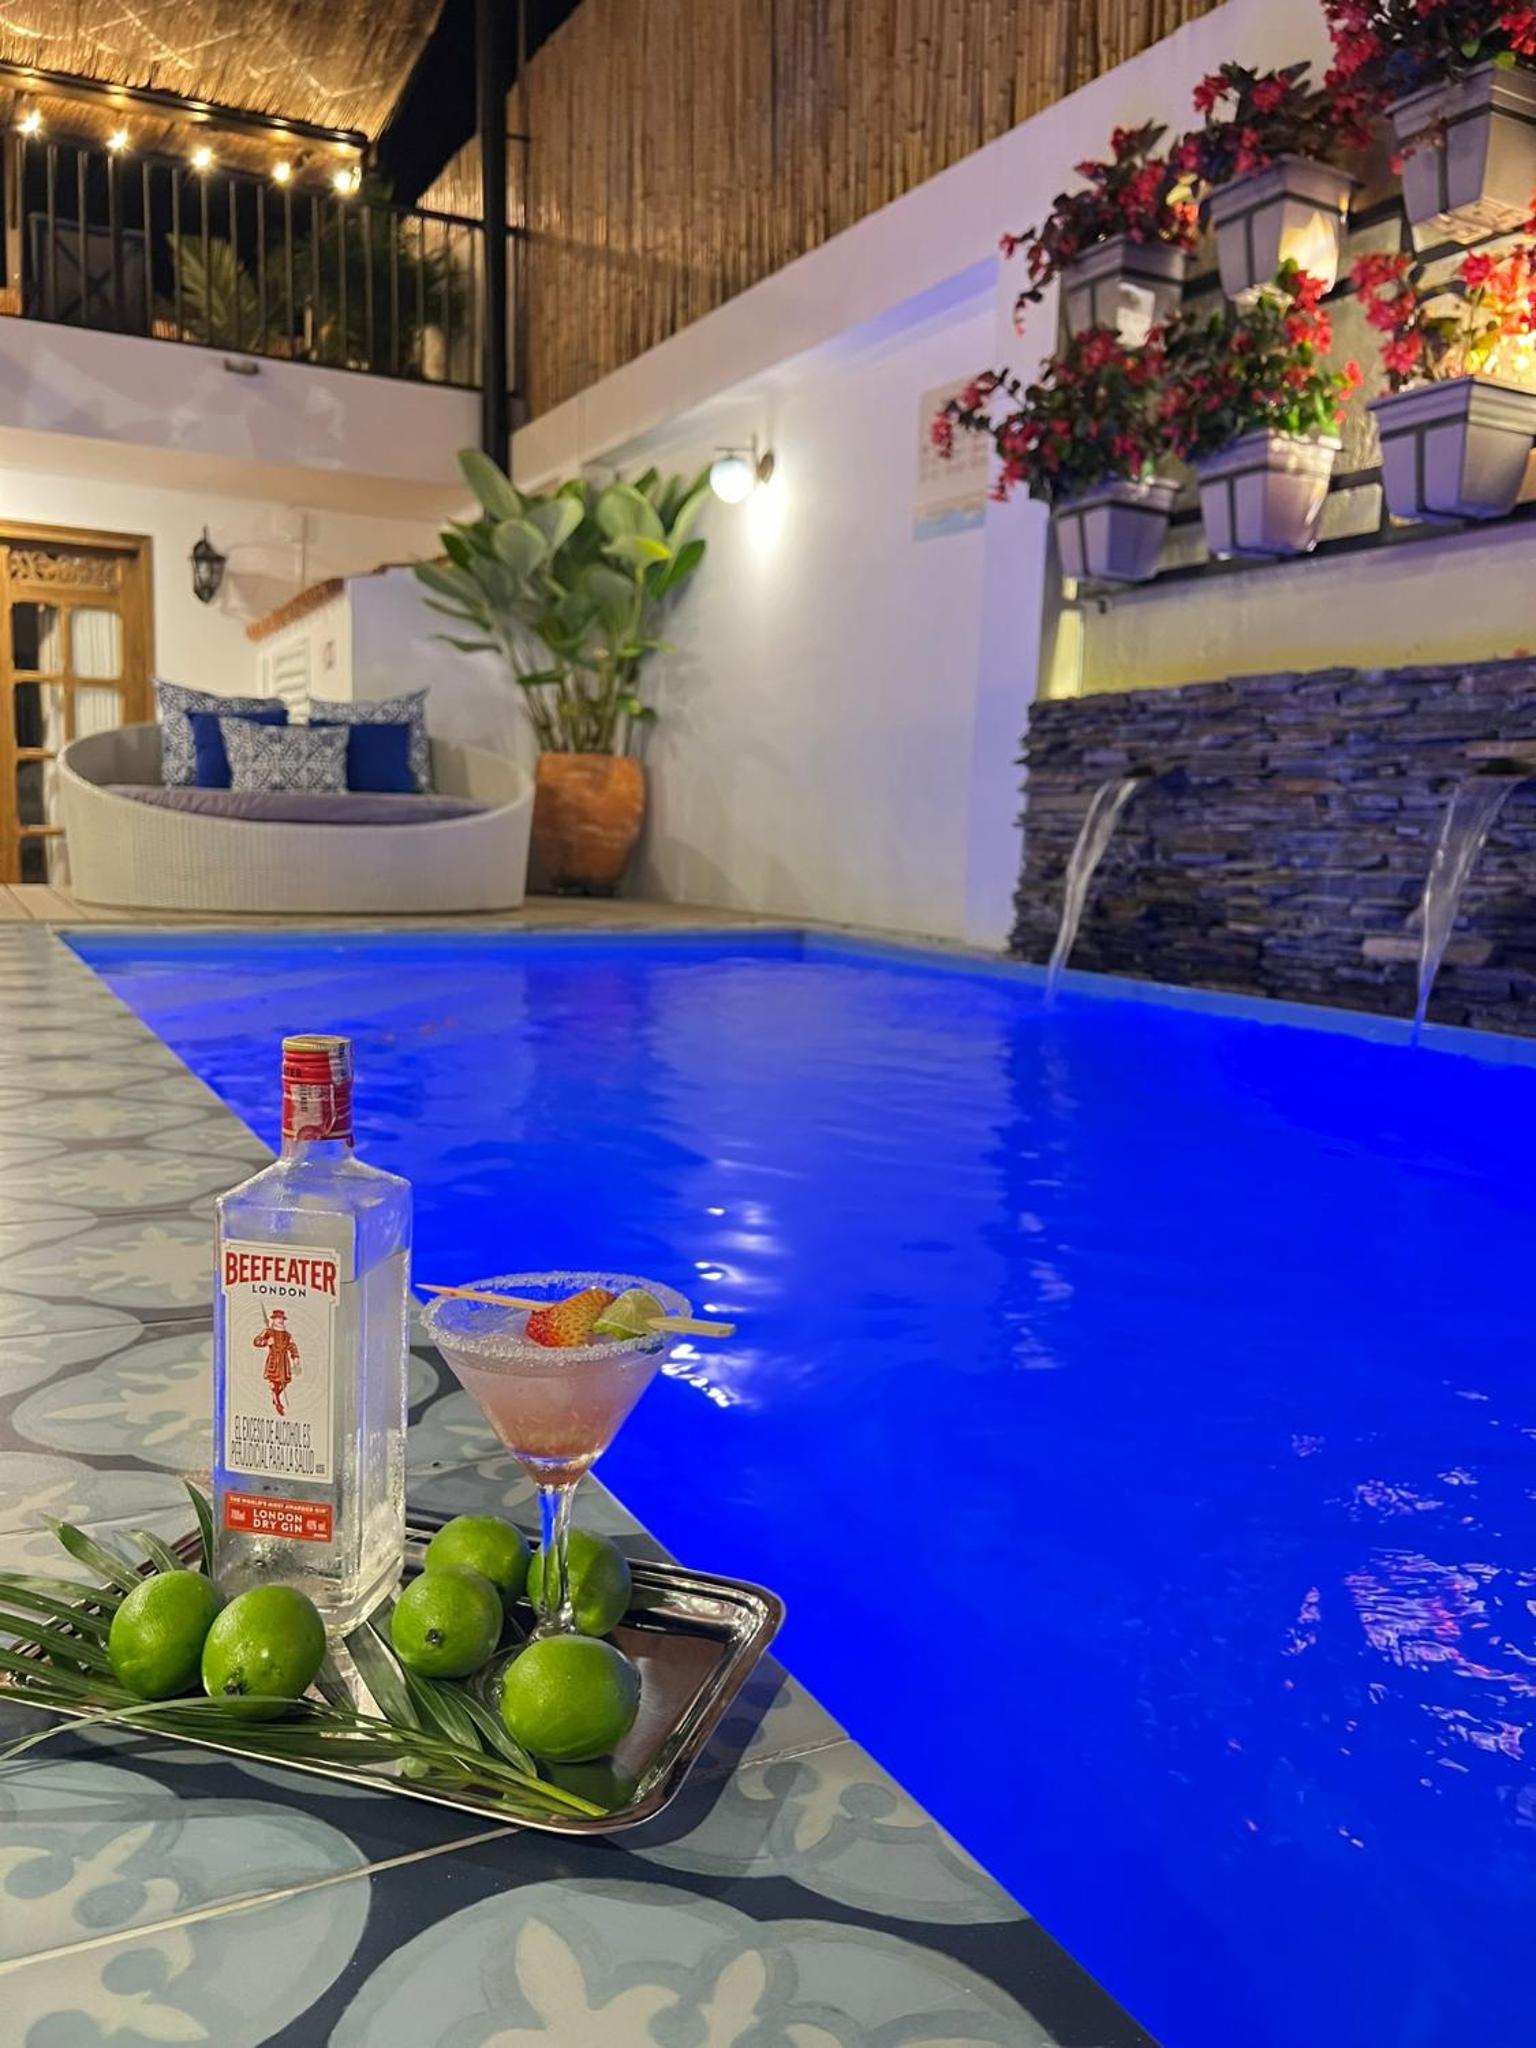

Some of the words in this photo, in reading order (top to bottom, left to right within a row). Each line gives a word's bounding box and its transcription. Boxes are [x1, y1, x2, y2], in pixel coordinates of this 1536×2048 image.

[226, 1252, 336, 1296] BEEFEATER
[252, 1285, 306, 1297] LONDON
[235, 1415, 242, 1440] EL
[243, 1417, 265, 1443] EXCESO
[266, 1420, 274, 1444] DE
[303, 1423, 310, 1448] ES
[269, 1445, 285, 1470] PARA
[295, 1449, 314, 1474] SALUD
[253, 1509, 303, 1523] LONDON
[253, 1519, 277, 1530] DRY
[281, 1523, 303, 1533] GIN
